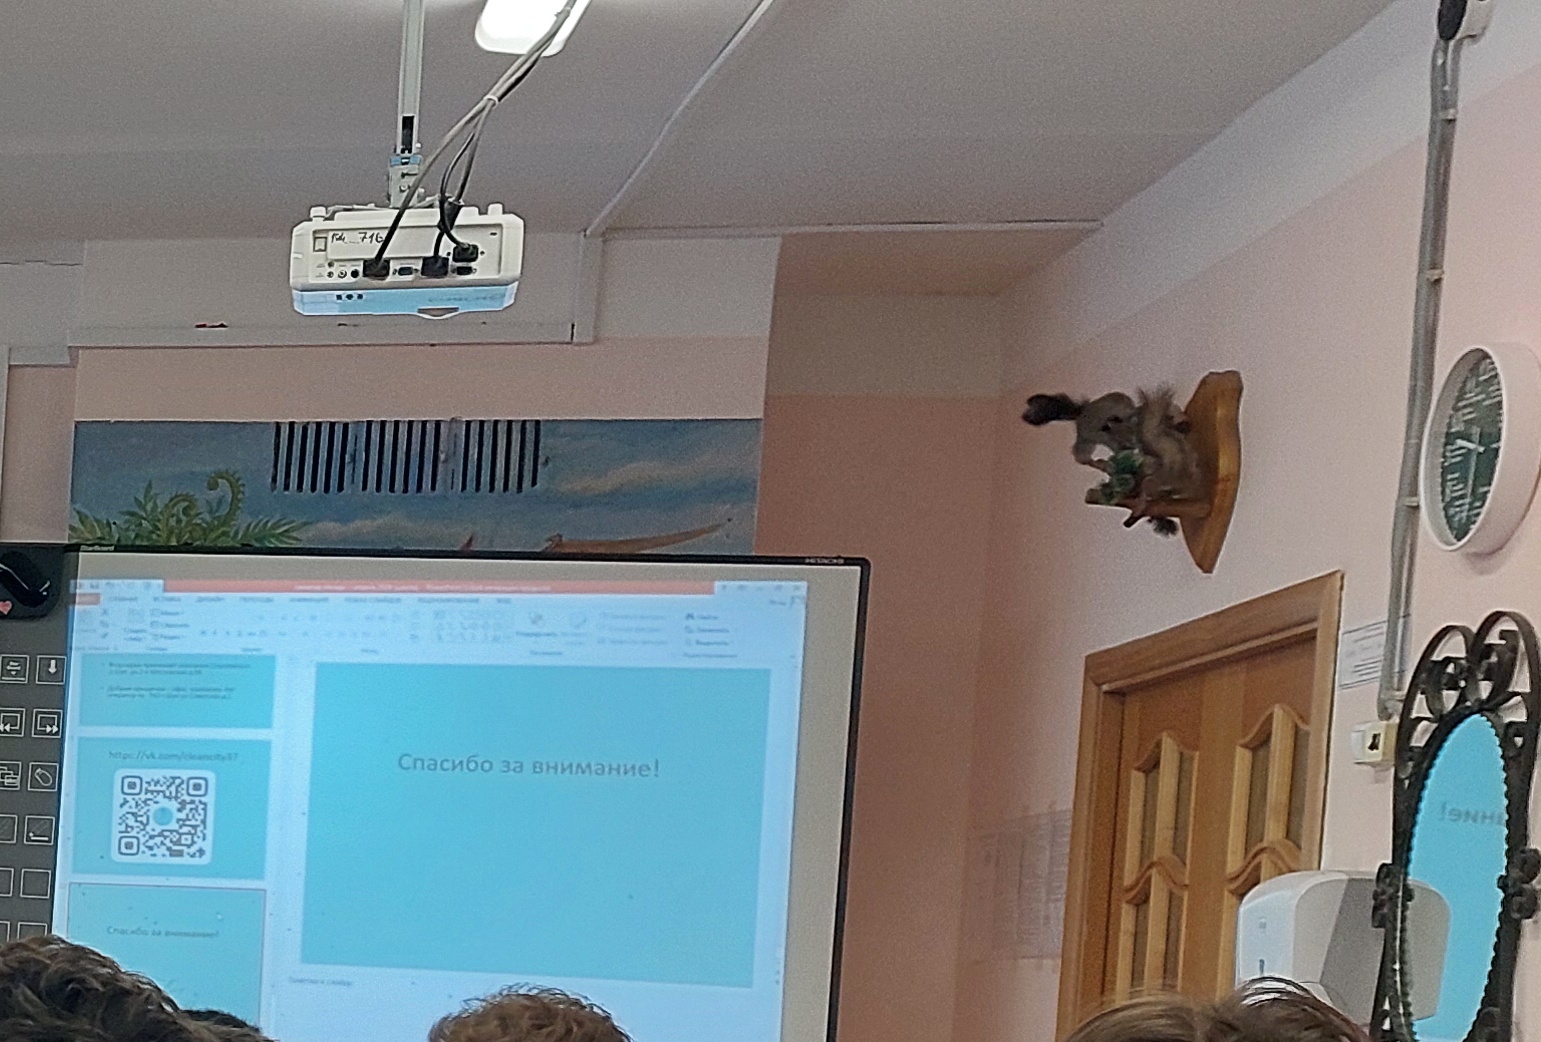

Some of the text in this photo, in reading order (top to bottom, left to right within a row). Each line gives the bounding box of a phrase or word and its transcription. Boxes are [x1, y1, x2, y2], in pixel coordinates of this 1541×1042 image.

[397, 753, 660, 779] Спасибо за внимание!
